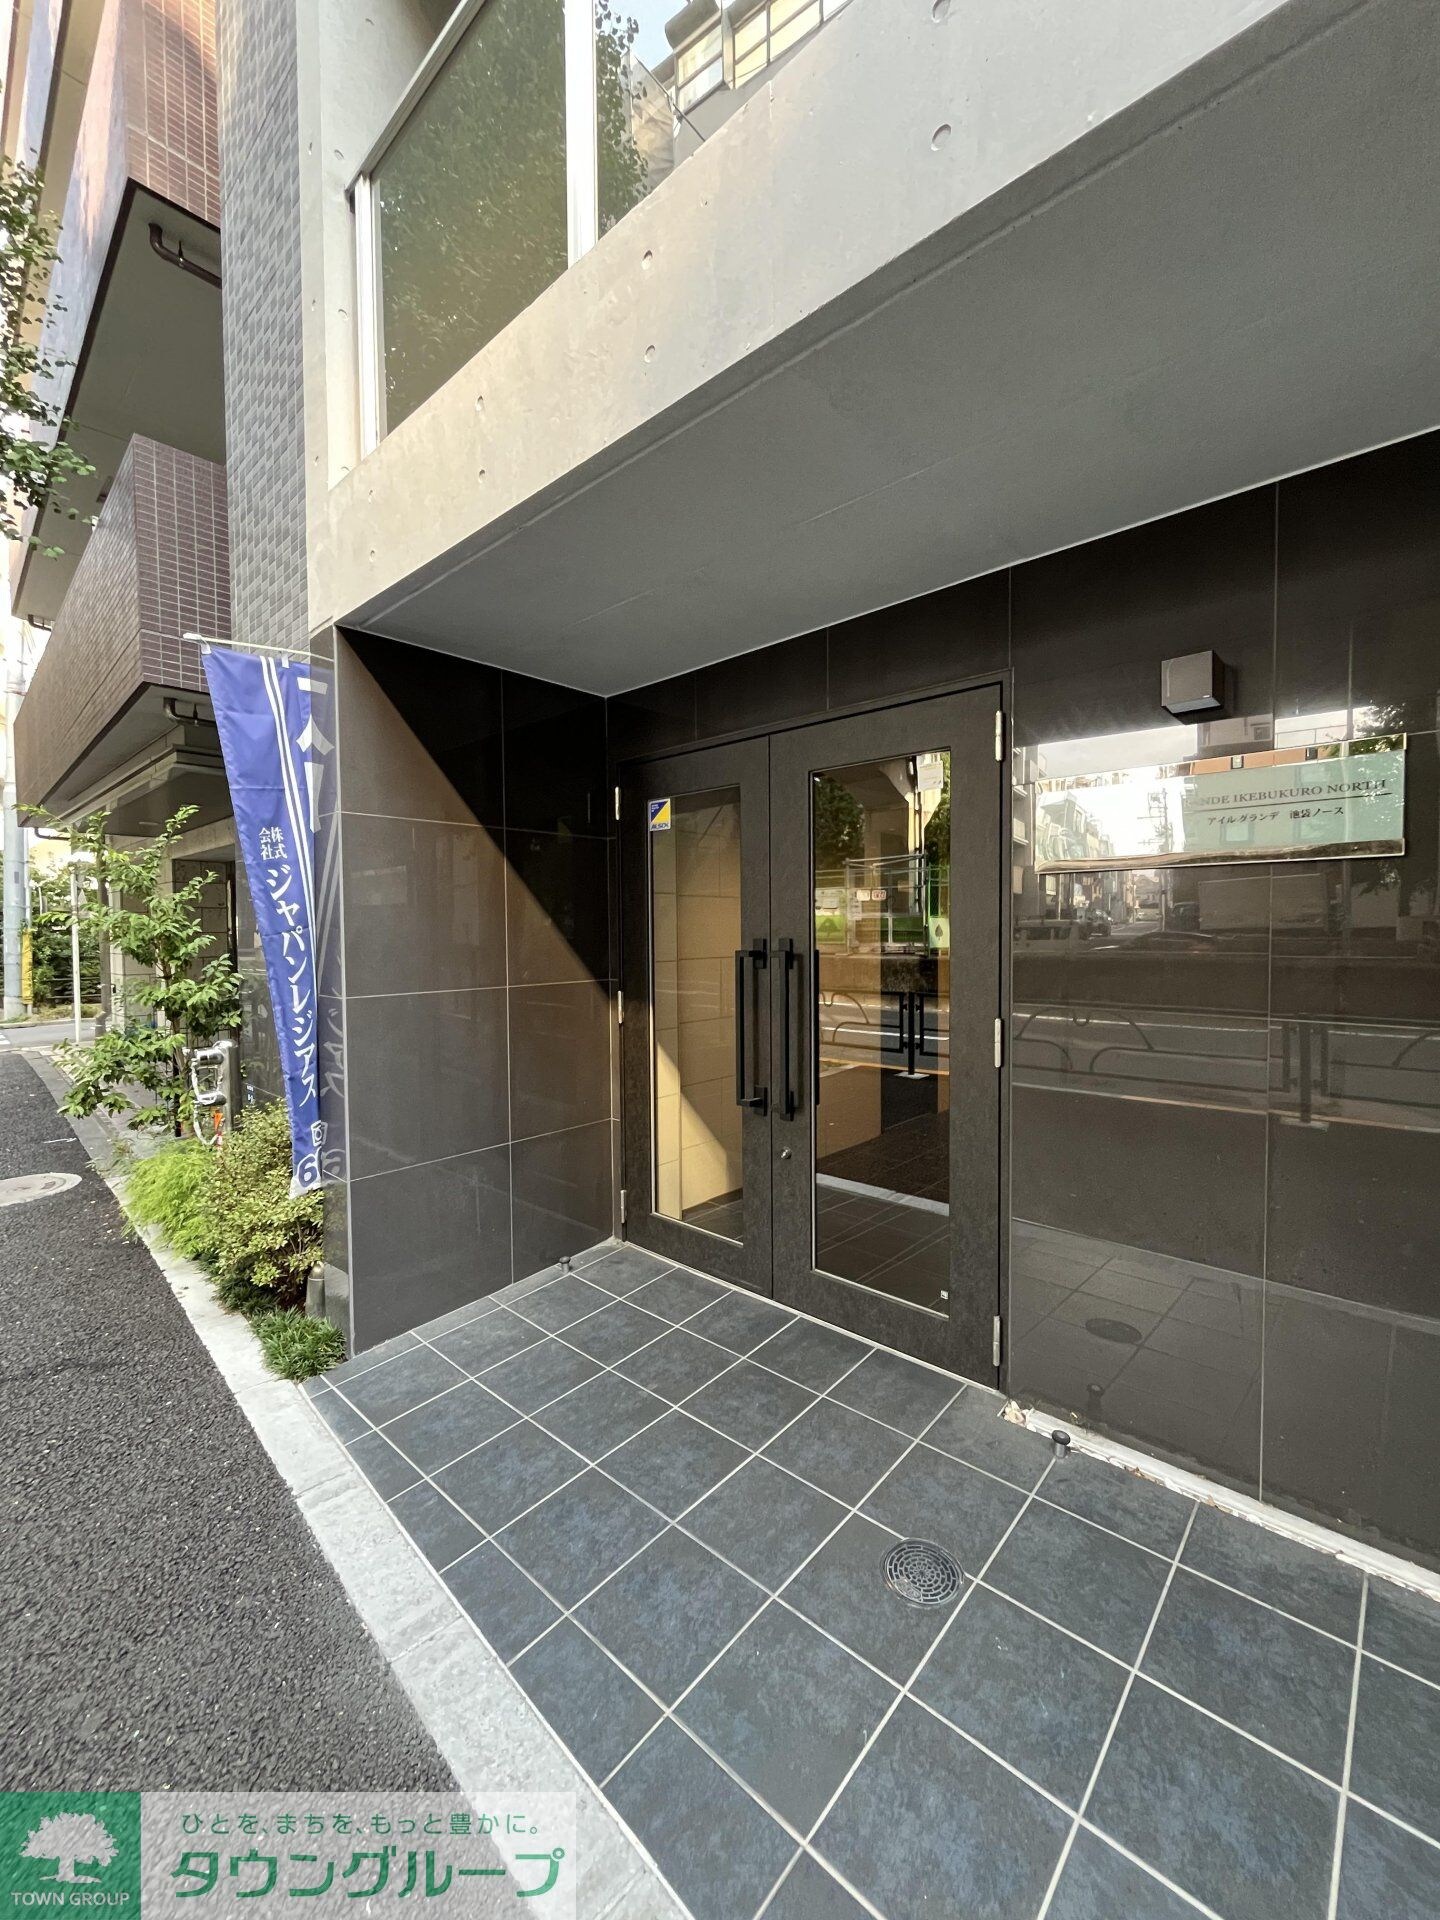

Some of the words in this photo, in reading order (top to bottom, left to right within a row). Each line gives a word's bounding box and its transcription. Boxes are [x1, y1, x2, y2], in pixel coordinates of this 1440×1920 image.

[1234, 786, 1323, 802] IKEBUKURO
[1327, 779, 1387, 794] NORTH
[1208, 811, 1279, 826] アイルグランデ
[1290, 806, 1344, 820] 池袋ノース
